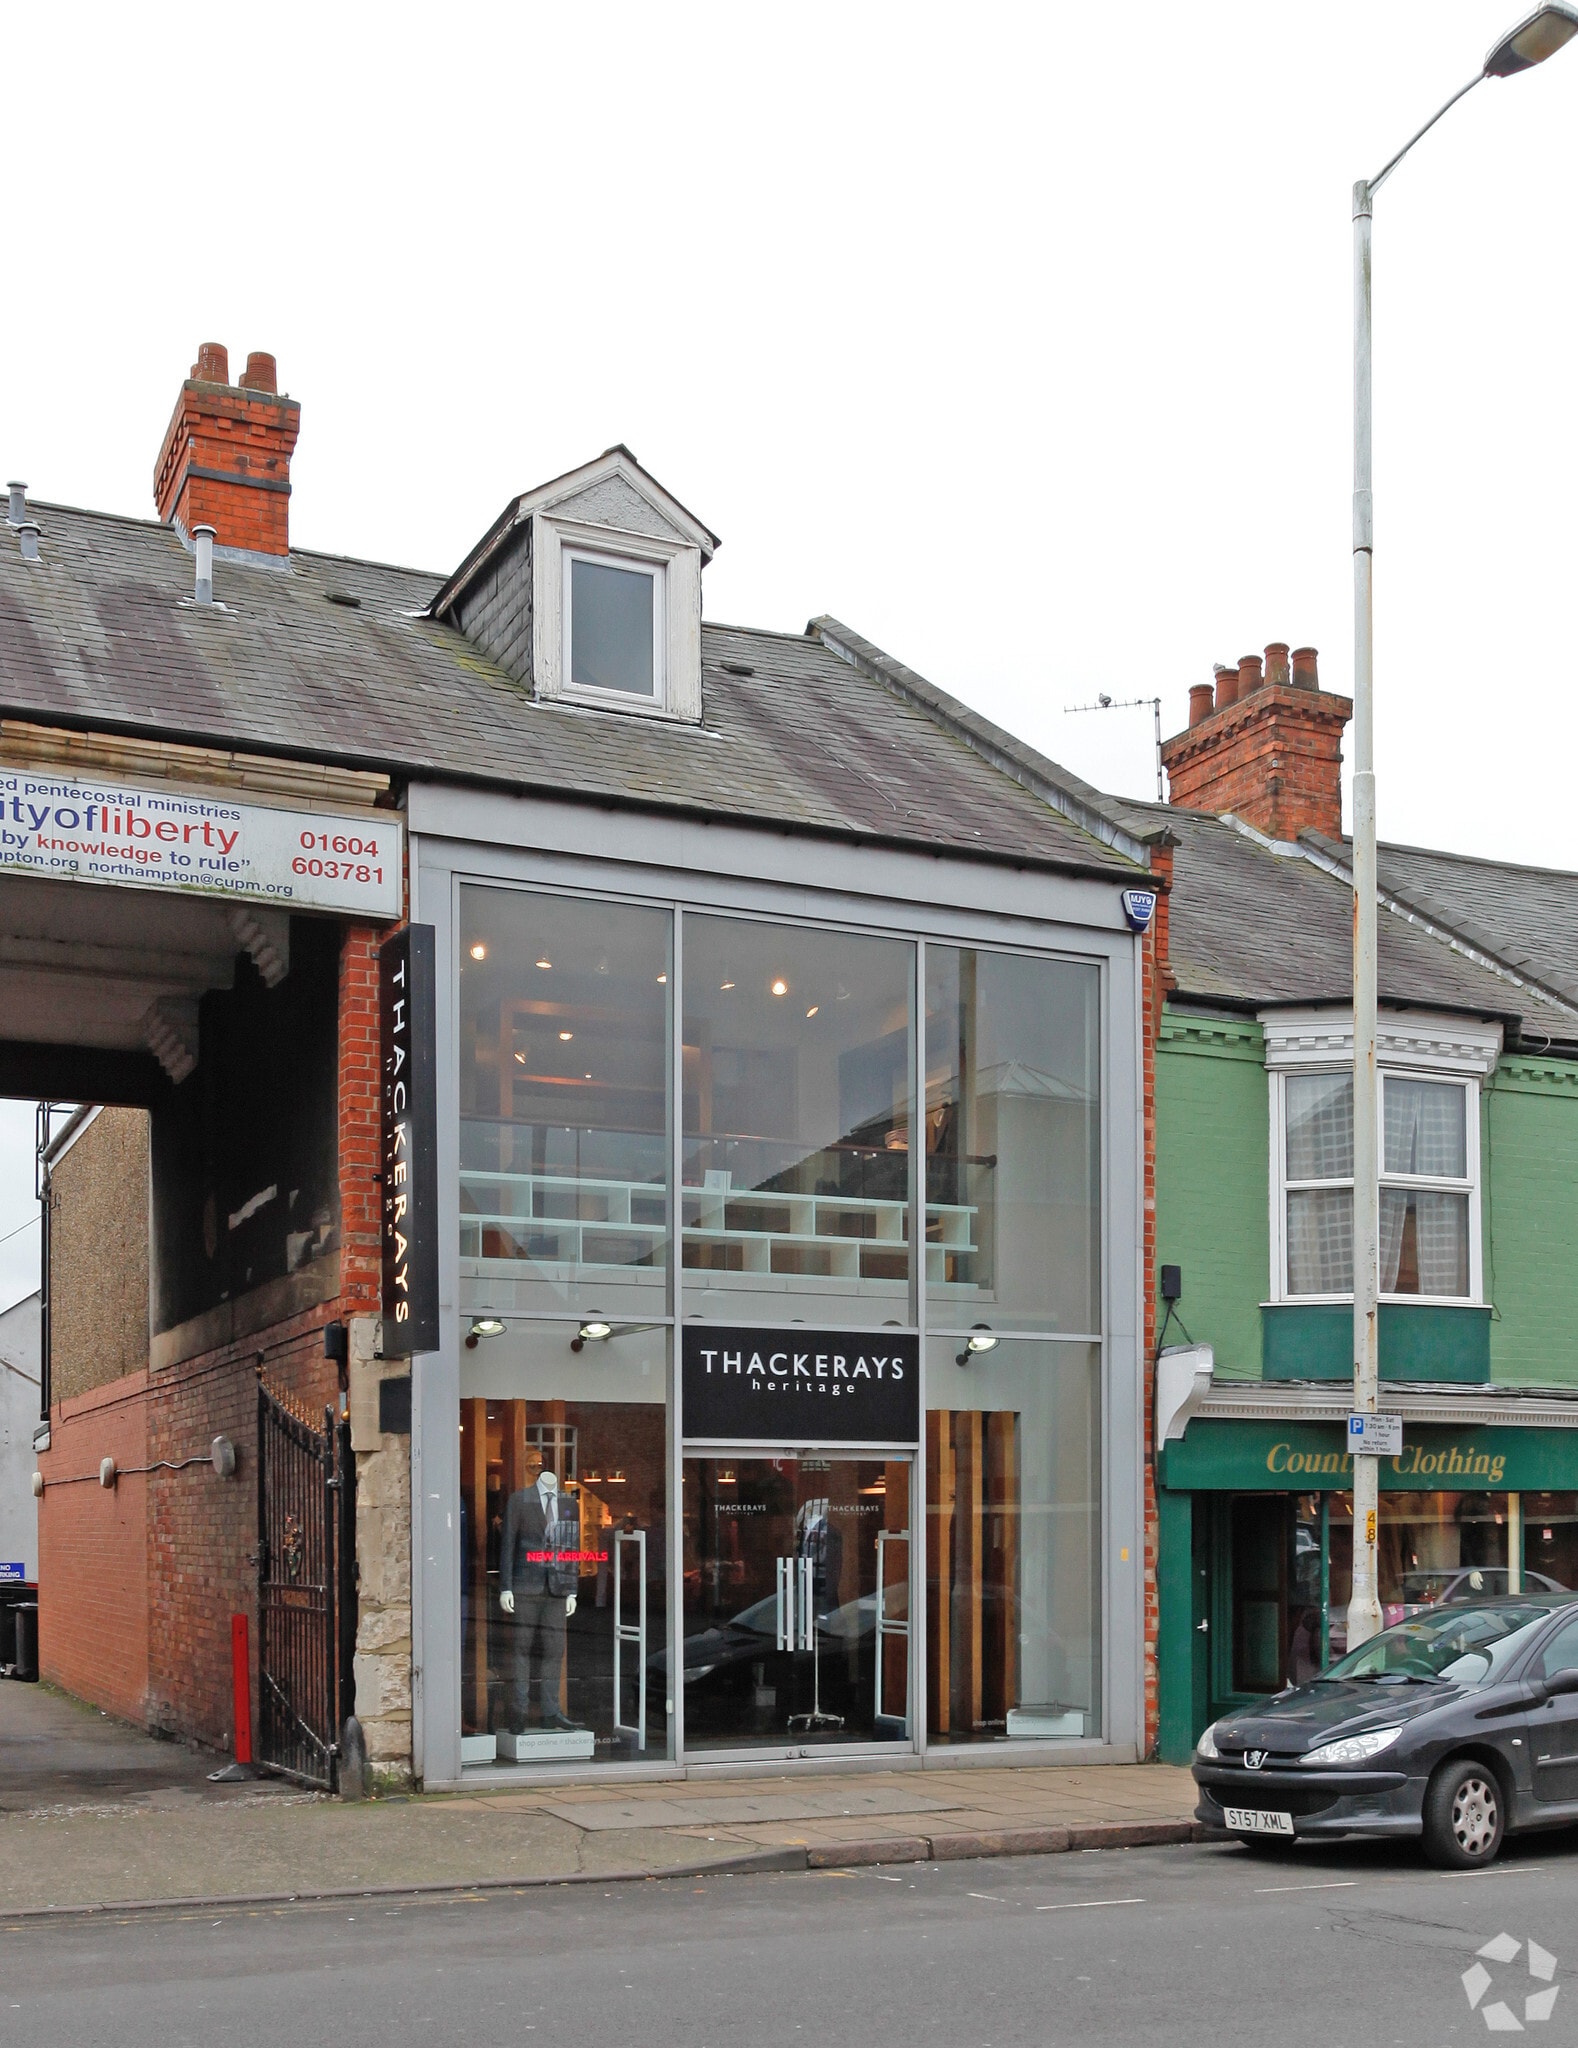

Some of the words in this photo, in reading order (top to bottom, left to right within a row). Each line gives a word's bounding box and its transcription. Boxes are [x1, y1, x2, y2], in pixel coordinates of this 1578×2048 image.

[25, 782, 141, 807] pentecostal
[147, 799, 241, 820] ministries
[2, 829, 29, 849] by
[37, 834, 163, 864] knowledge
[169, 851, 191, 866] to
[300, 831, 379, 857] 01604
[0, 851, 79, 871] pton.org
[89, 862, 293, 897] northampton@cupm.org
[291, 857, 382, 884] 603781
[392, 959, 409, 1324] THACKERAYS
[700, 1350, 904, 1380] THACKERAYS
[752, 1379, 855, 1395] heritage
[1267, 1443, 1354, 1473] Count
[1392, 1446, 1506, 1482] Clothing
[526, 1551, 554, 1562] NEW
[557, 1551, 608, 1562] ARRIVALS
[1229, 1810, 1258, 1827] ST57
[1261, 1813, 1288, 1830] XML
